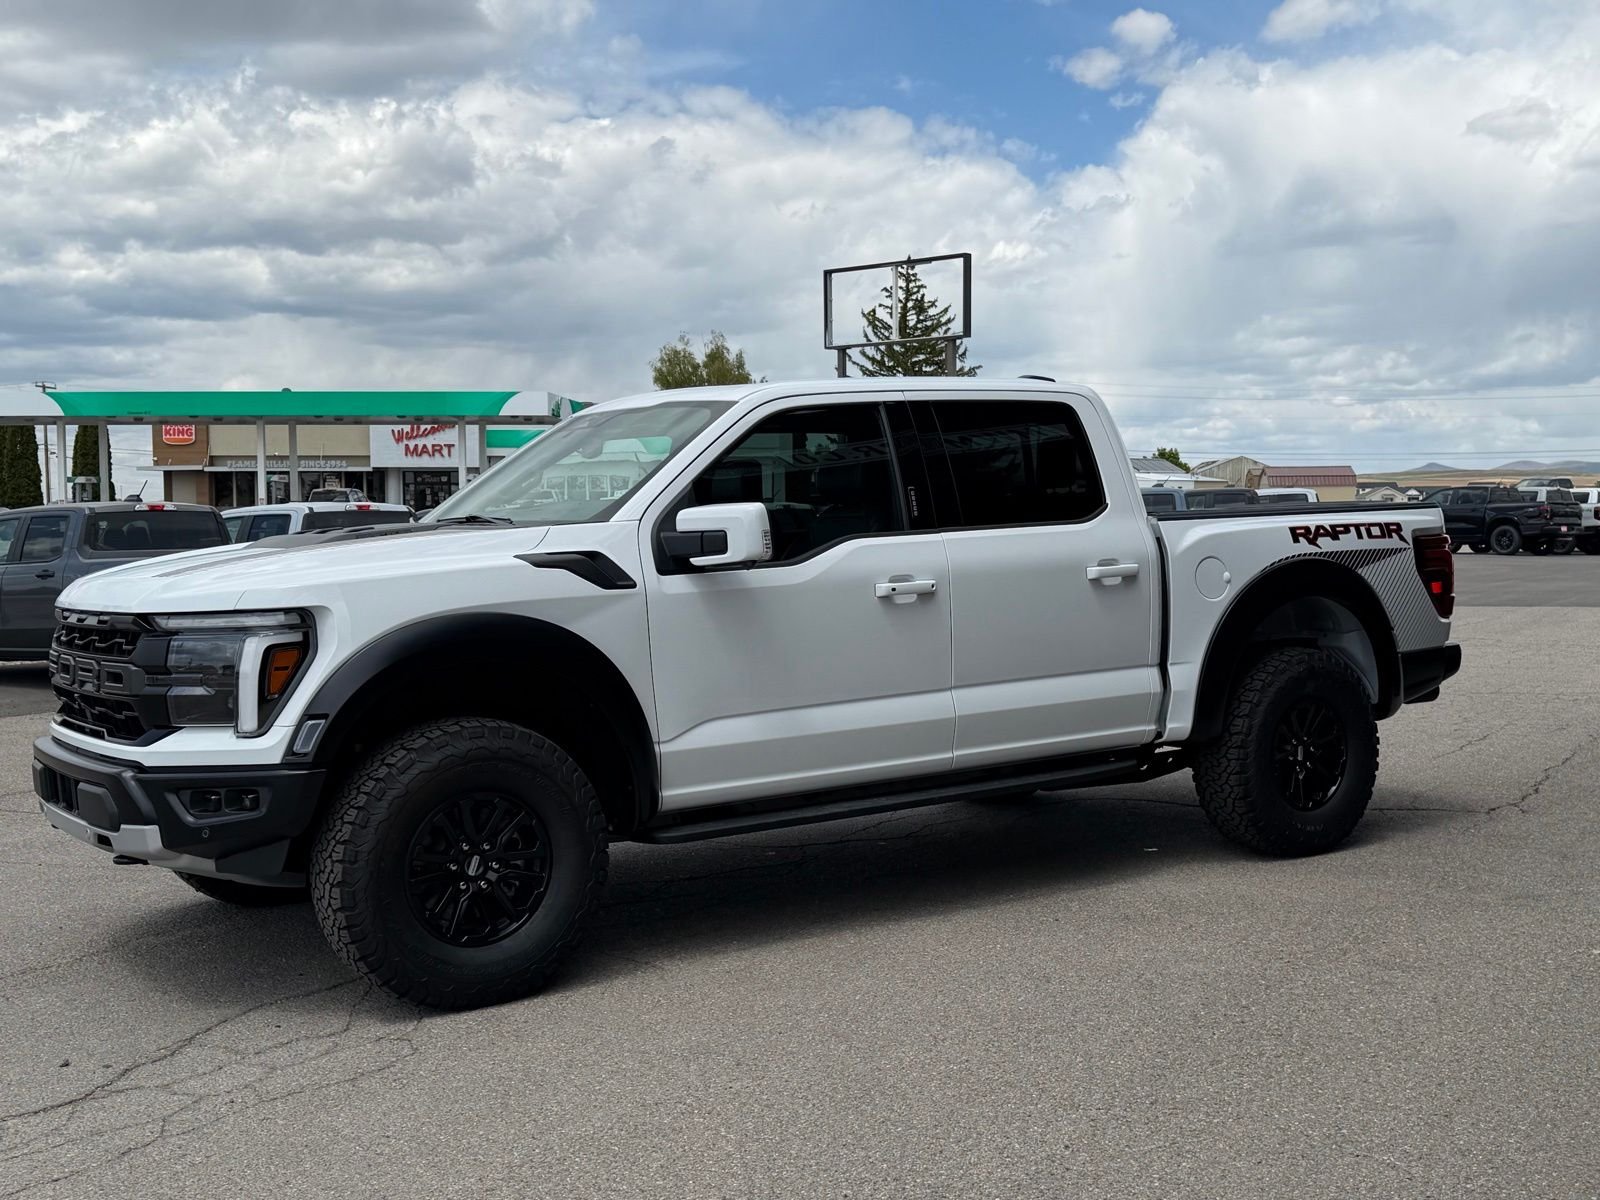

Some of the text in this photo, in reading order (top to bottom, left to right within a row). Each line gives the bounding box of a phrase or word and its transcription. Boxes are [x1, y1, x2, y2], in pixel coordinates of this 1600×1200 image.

[164, 427, 194, 437] KING
[404, 443, 455, 457] MART
[226, 460, 256, 468] FLAME
[299, 460, 326, 468] SINCE
[1288, 522, 1410, 549] RAPTOR
